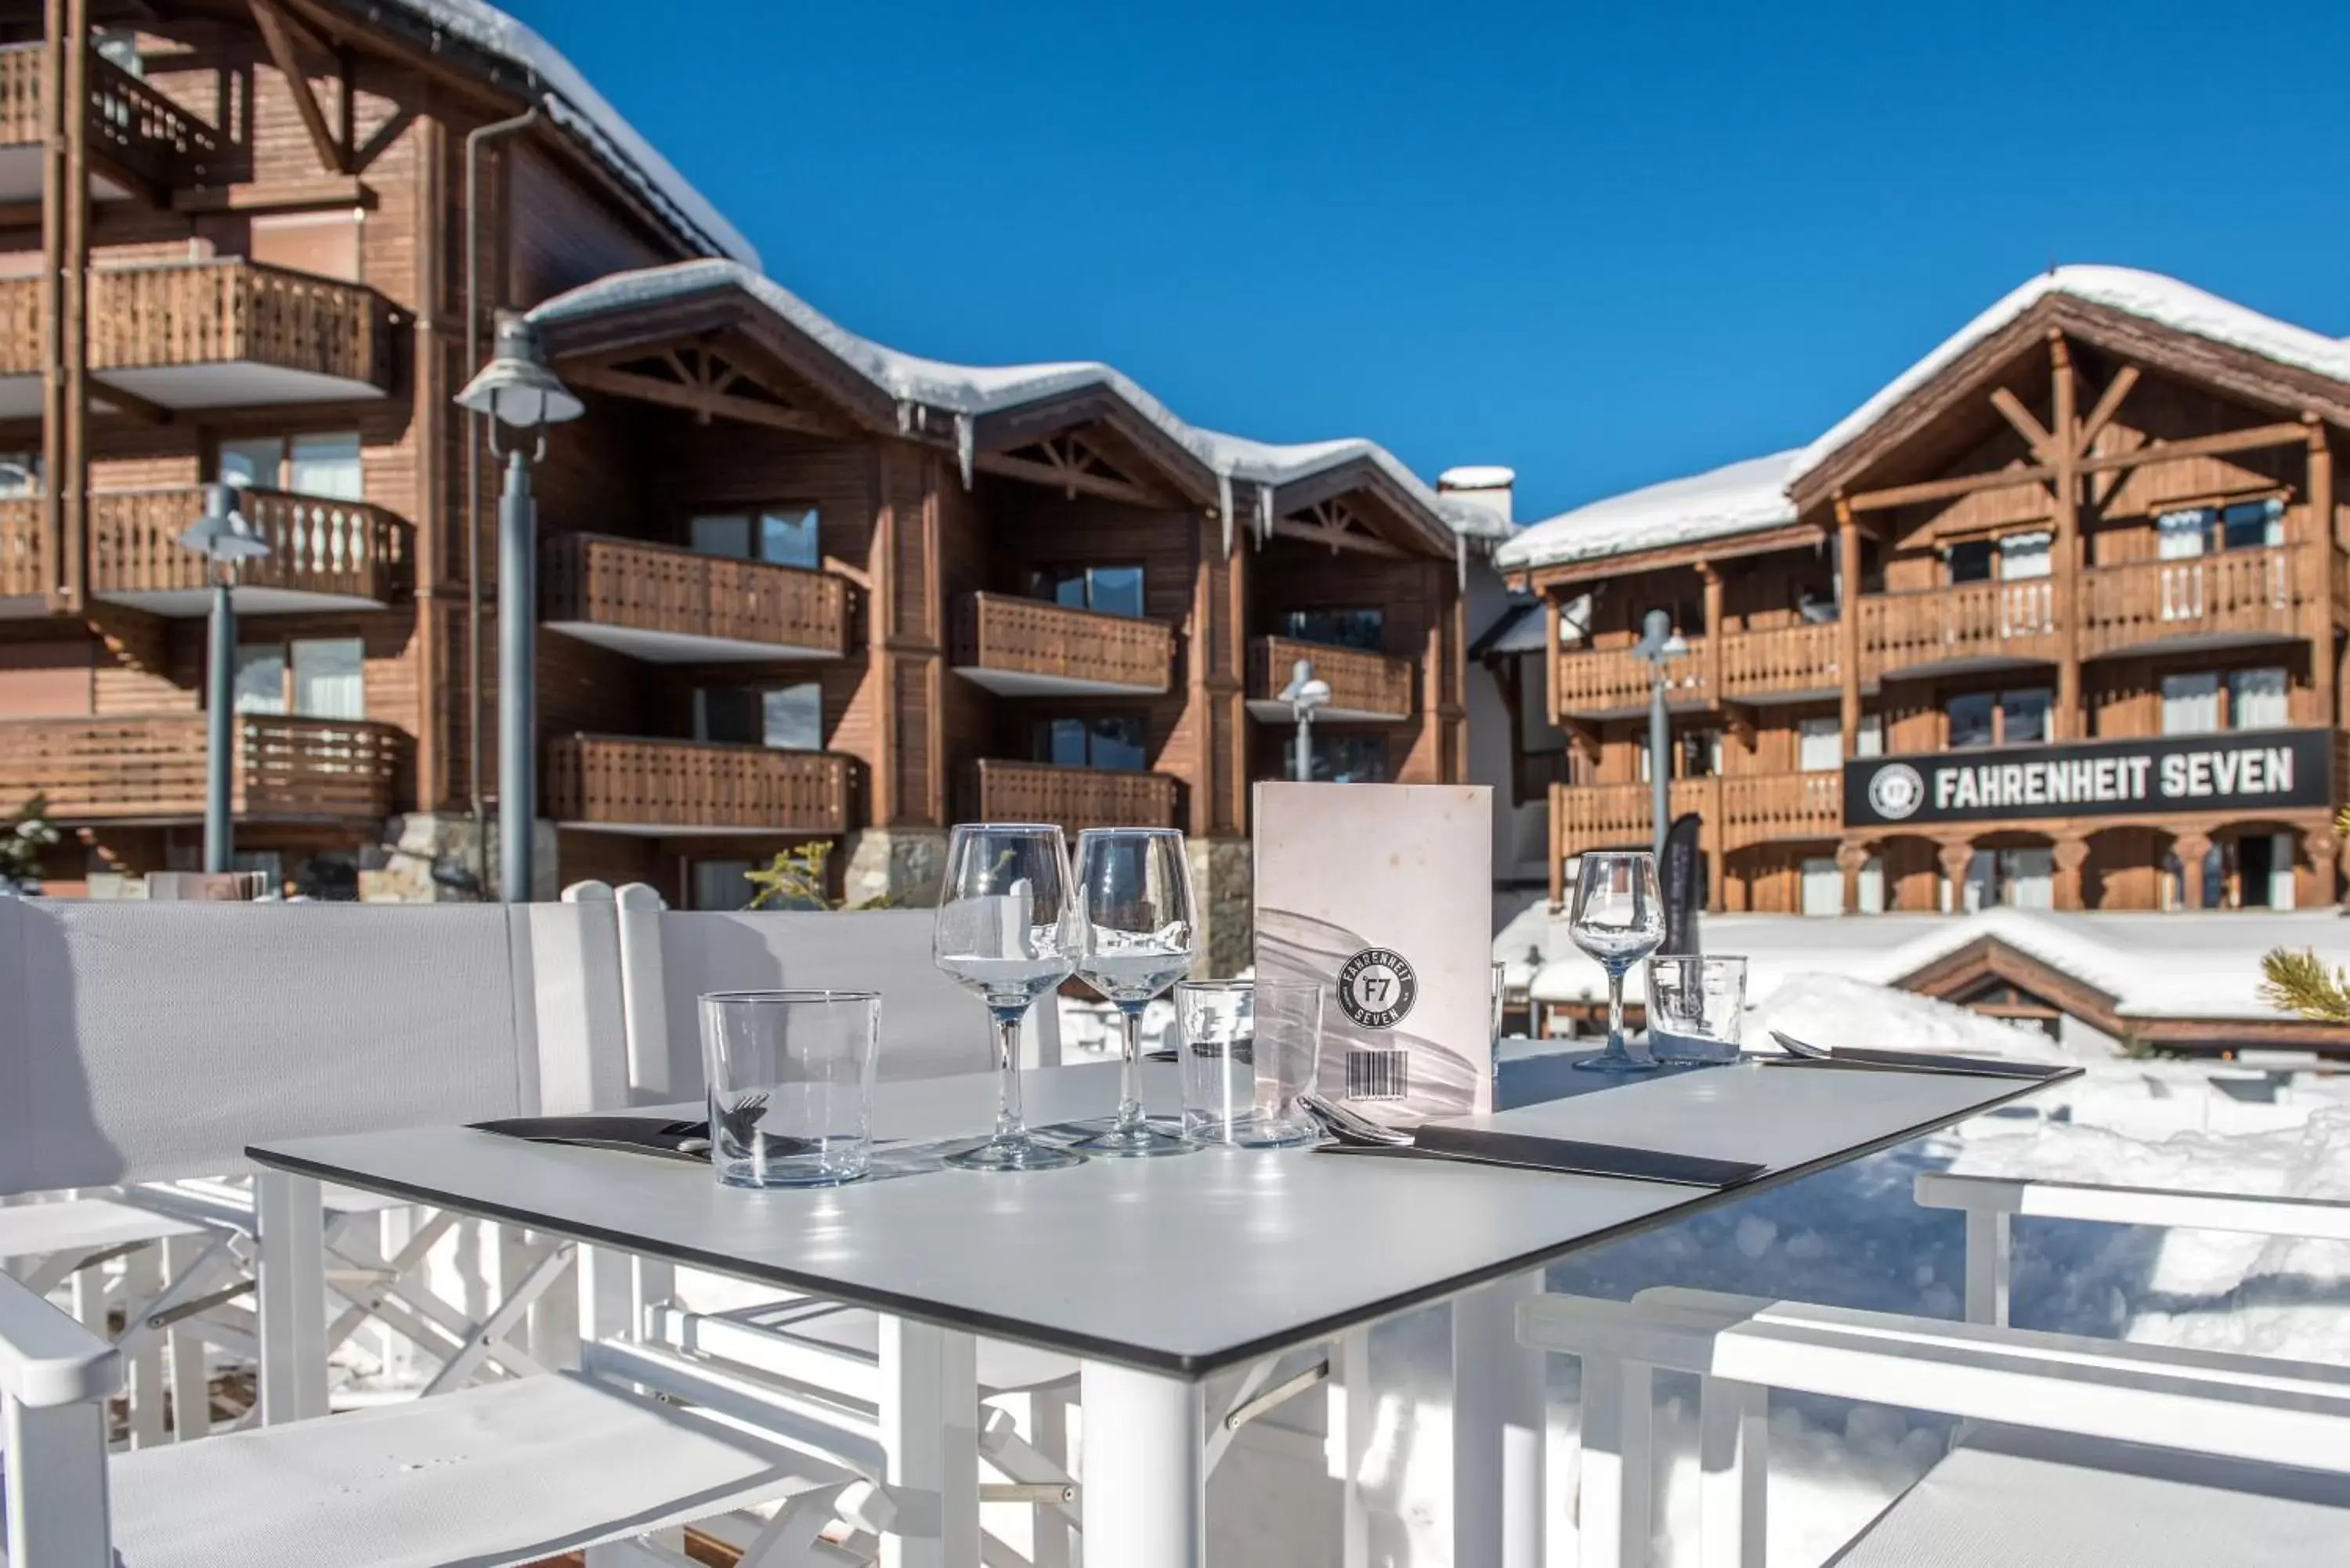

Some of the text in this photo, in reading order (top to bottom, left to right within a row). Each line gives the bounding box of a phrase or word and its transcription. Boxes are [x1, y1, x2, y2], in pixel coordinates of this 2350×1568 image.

[1935, 755, 2152, 809] FAHRENHEIT
[2160, 746, 2294, 797] SEVEN
[1343, 952, 1412, 981] FAHRENHEIT
[1354, 1008, 1400, 1025] SEVEN
